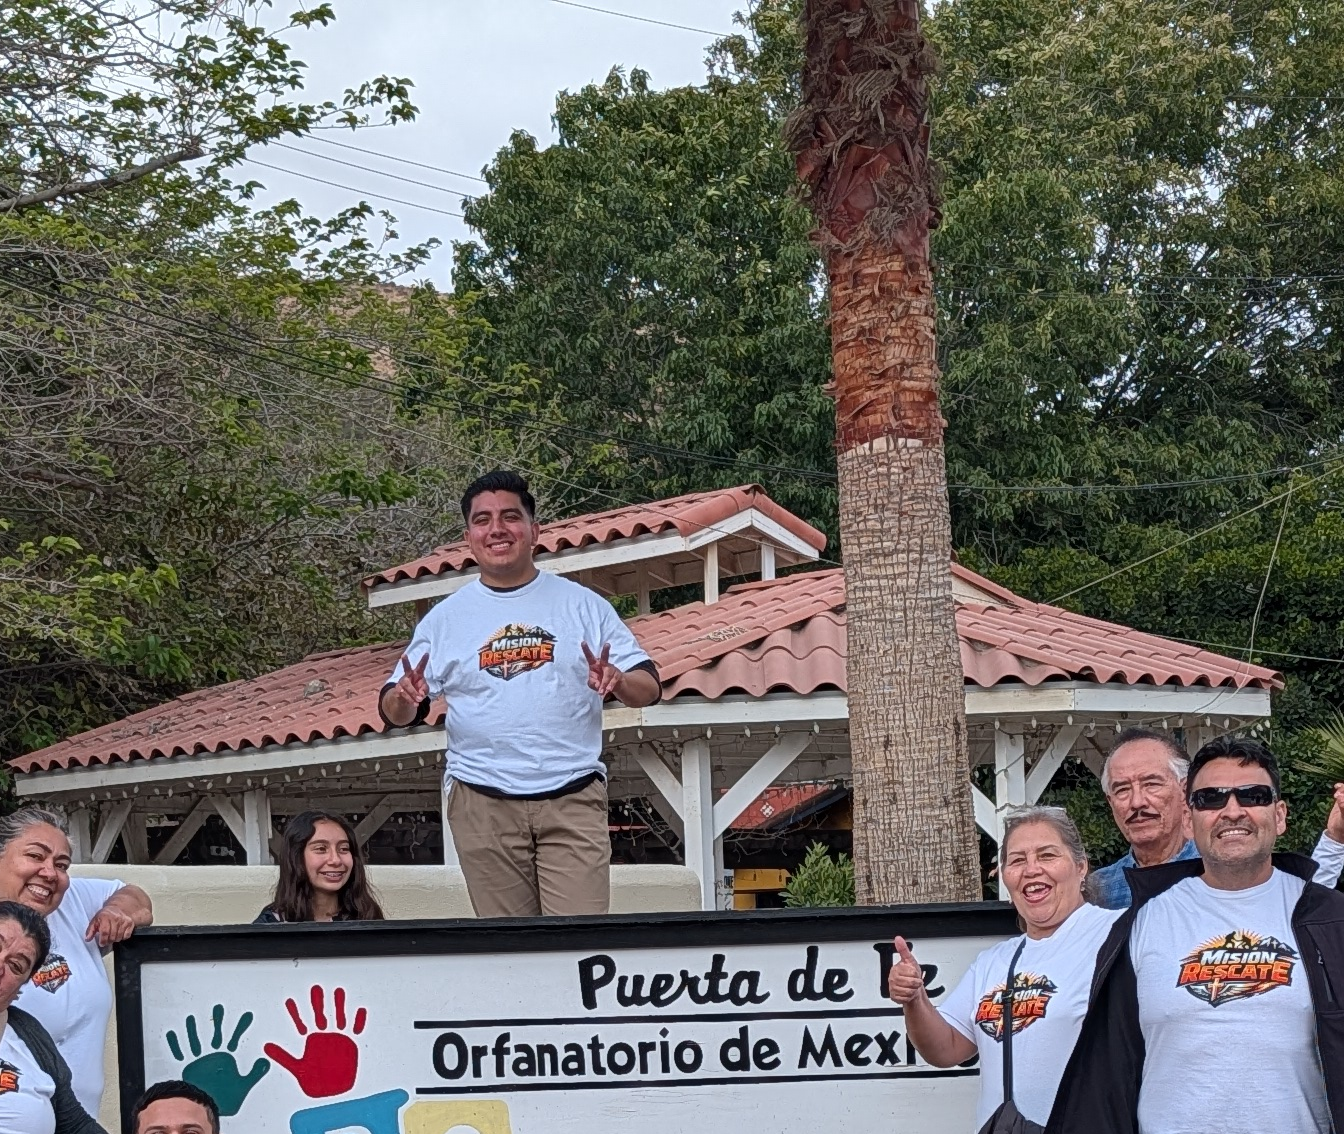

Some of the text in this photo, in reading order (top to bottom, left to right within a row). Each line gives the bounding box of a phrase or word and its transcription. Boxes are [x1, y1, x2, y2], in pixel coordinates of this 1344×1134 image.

[480, 644, 553, 667] RESCATE
[577, 953, 771, 1011] Puerta
[787, 945, 855, 1002] de
[1179, 960, 1291, 984] RESCATE
[976, 996, 1050, 1020] RECATE
[432, 1027, 704, 1081] Orfanatorio
[719, 1024, 782, 1071] de
